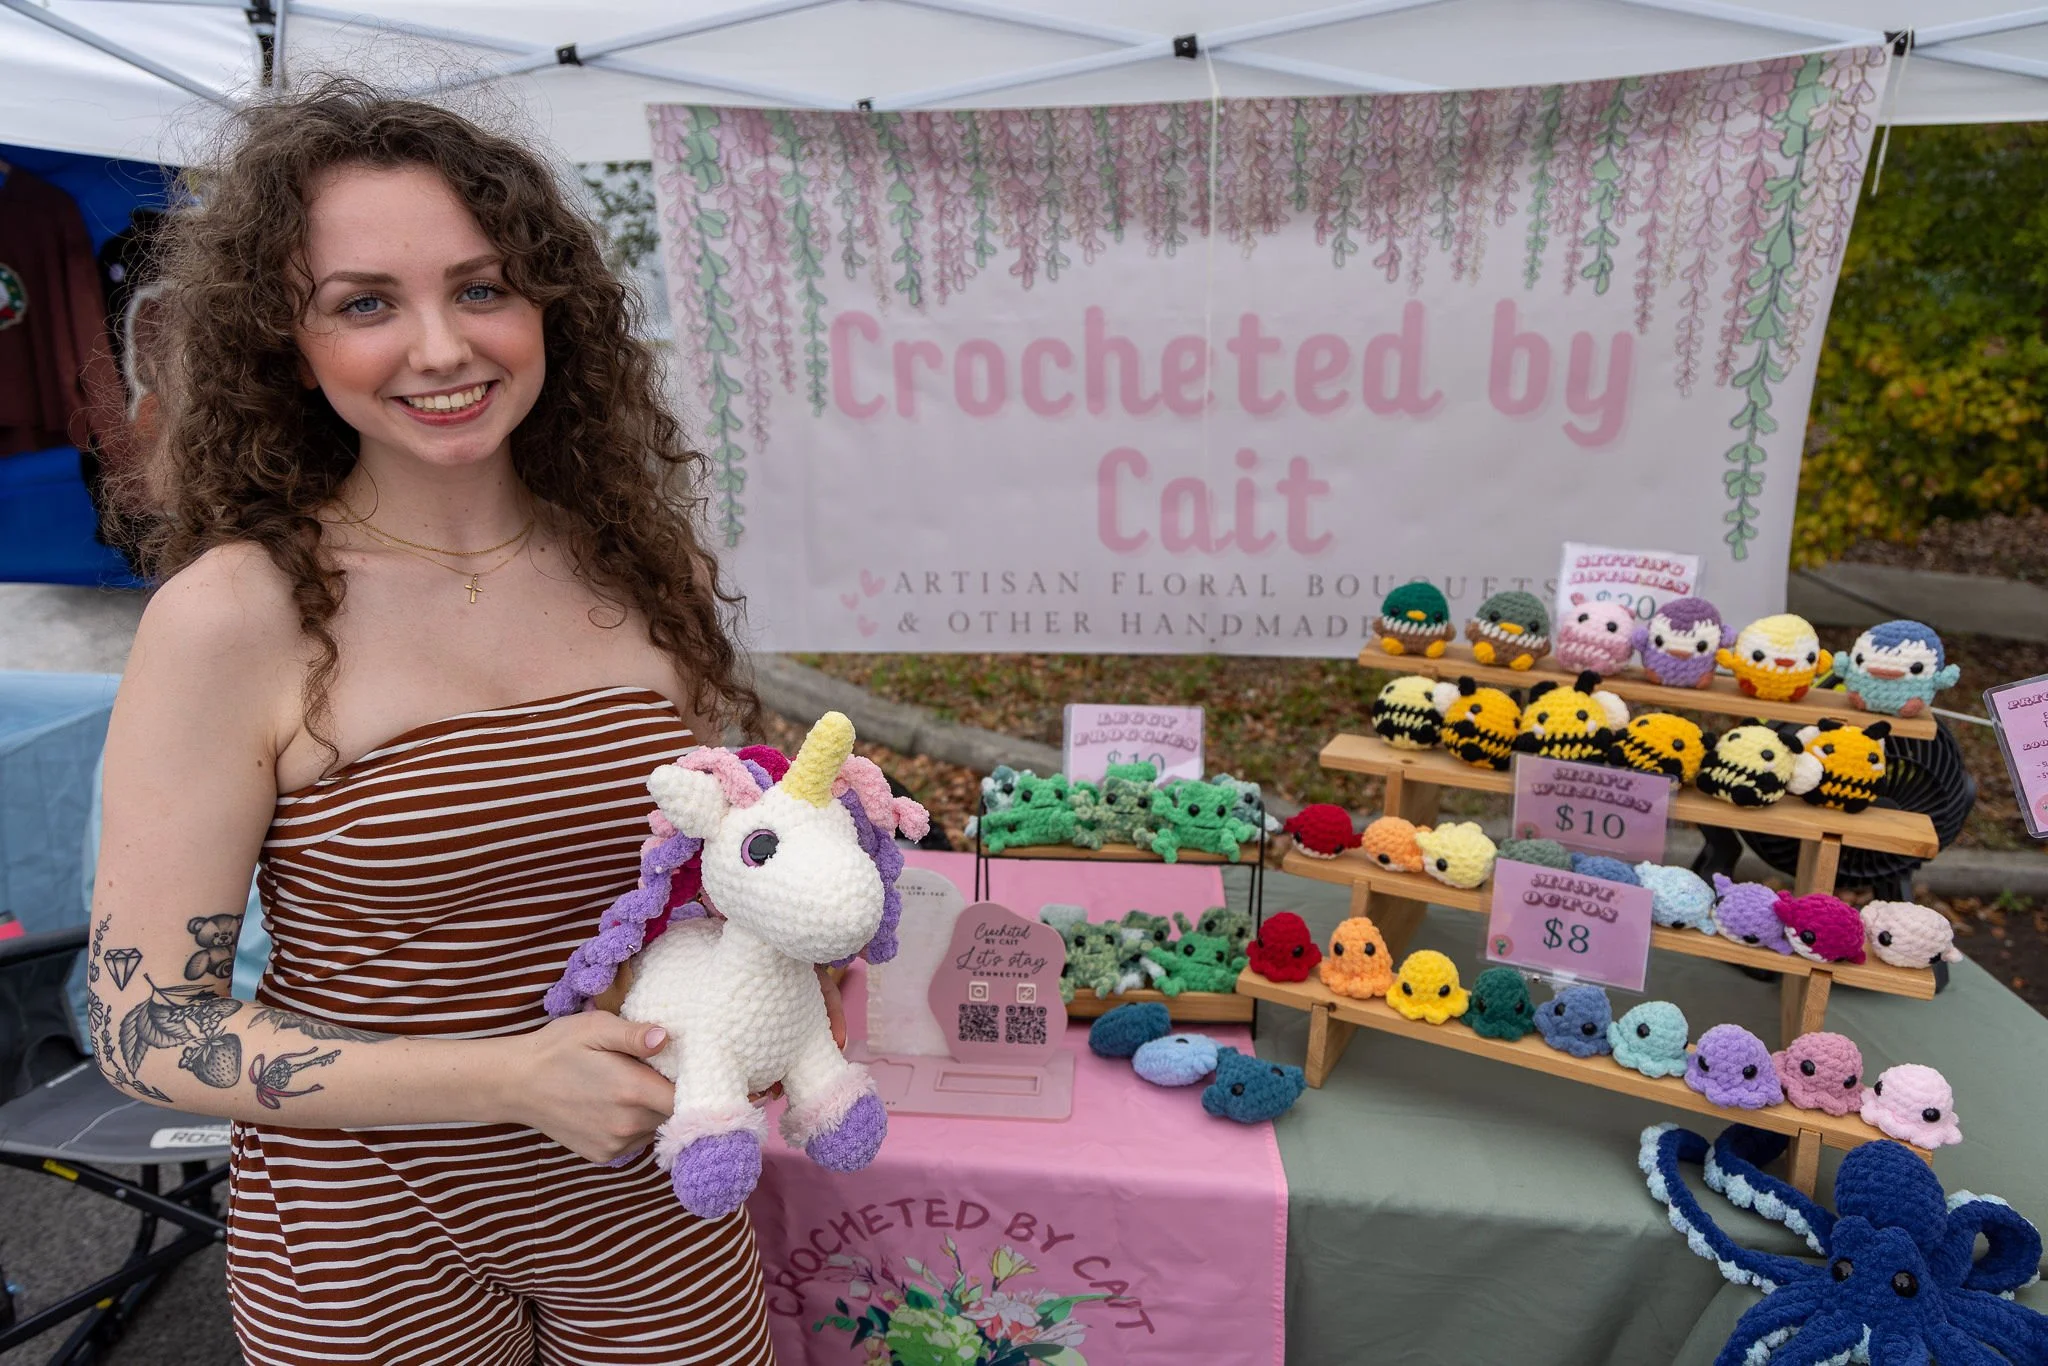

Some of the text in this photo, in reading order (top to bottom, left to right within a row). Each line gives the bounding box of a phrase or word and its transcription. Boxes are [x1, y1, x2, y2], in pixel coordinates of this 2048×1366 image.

[828, 298, 1635, 450] Crocheted by
[1096, 446, 1335, 556] Cait
[894, 570, 1558, 602] ARTISAN FLORAL BOUUETS
[896, 610, 920, 634] &
[947, 610, 1092, 636] OTHER
[1531, 783, 1653, 814] WHALES
[1555, 803, 1625, 839] $10
[1530, 873, 1616, 903] MINI
[1522, 890, 1619, 924] OCTOS
[974, 922, 1031, 940] Crocheted
[1543, 917, 1590, 954] $8
[956, 946, 1048, 975] Let's stay
[972, 971, 1029, 979] CONNECTED
[768, 1198, 990, 1318] CROCHETED
[1005, 1212, 1075, 1253] BY
